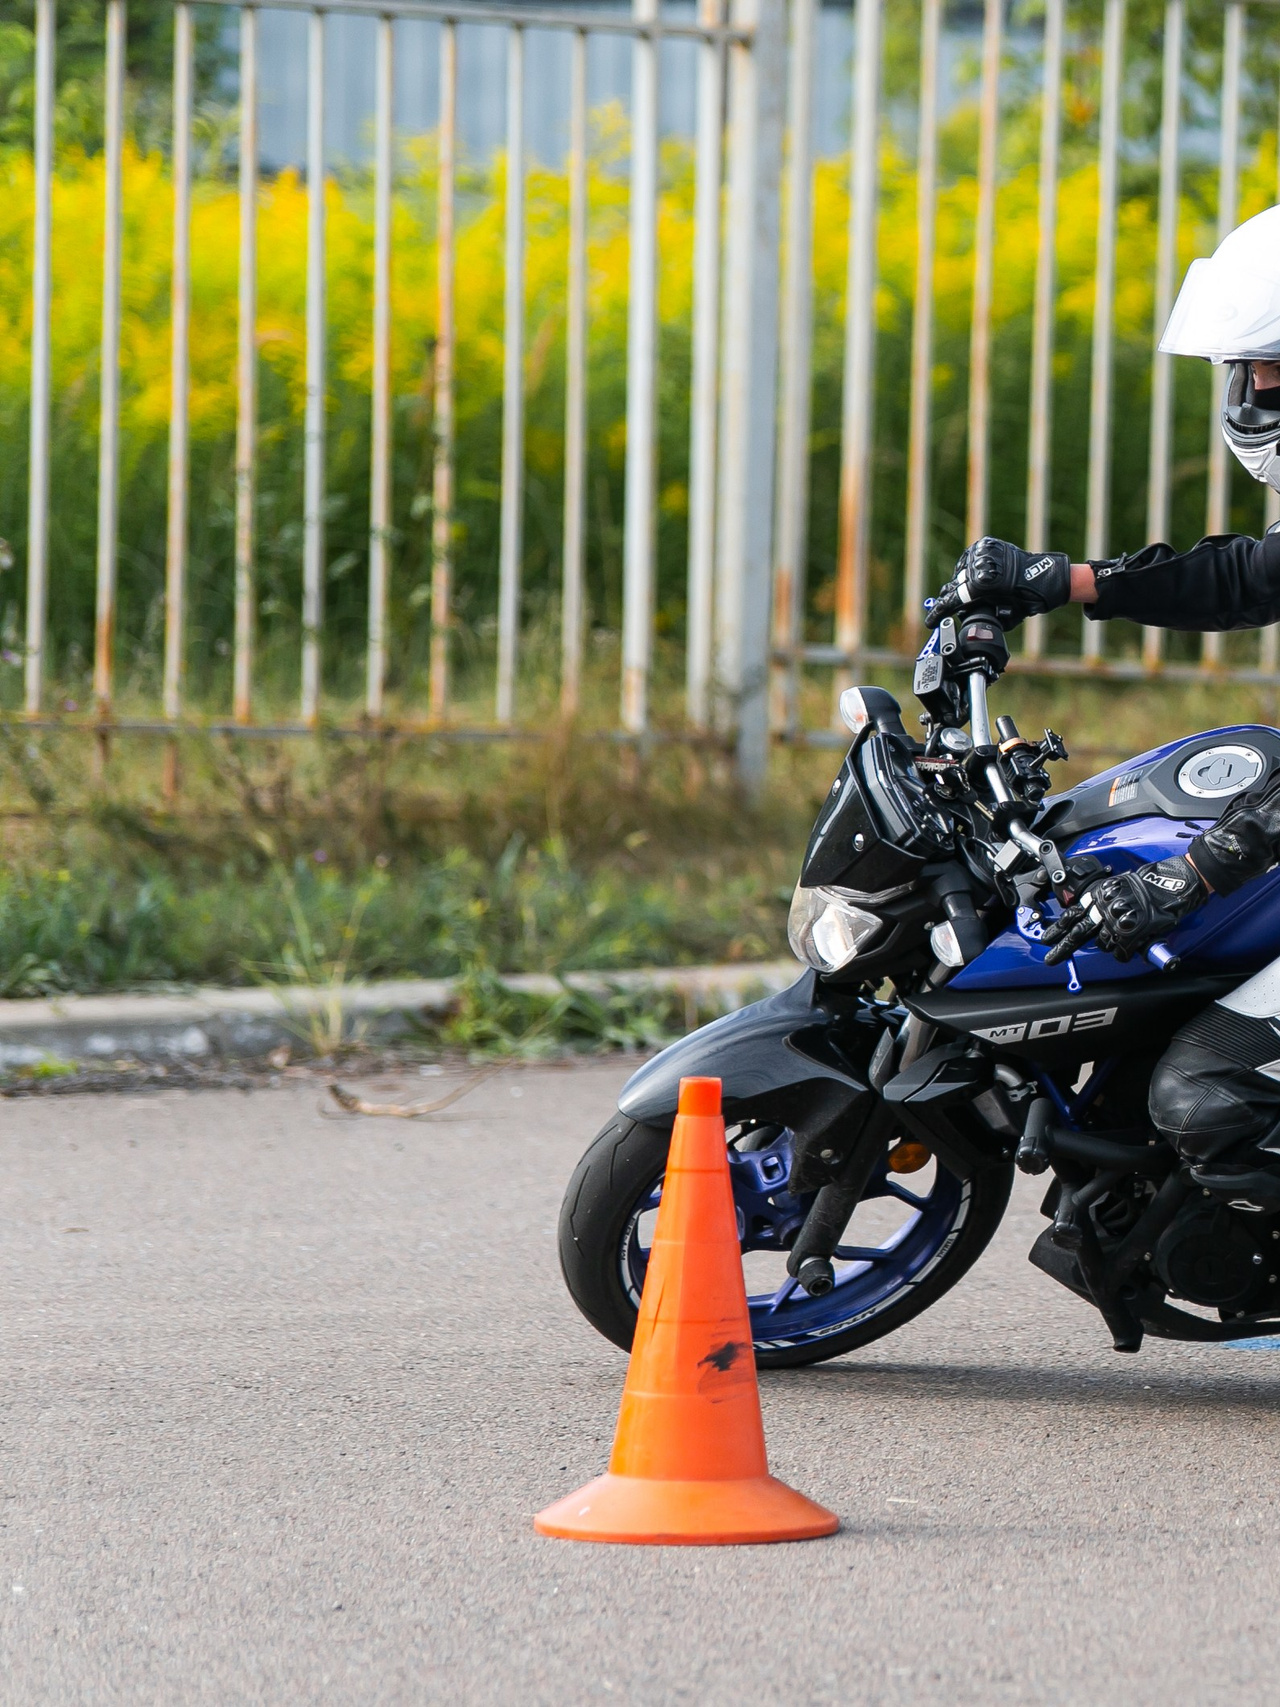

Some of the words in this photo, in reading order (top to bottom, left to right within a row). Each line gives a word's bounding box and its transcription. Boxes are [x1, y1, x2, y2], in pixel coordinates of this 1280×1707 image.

[1025, 557, 1051, 580] MCP
[1145, 873, 1185, 890] MCP
[989, 1025, 1025, 1038] MT
[1027, 1007, 1119, 1040] 03
